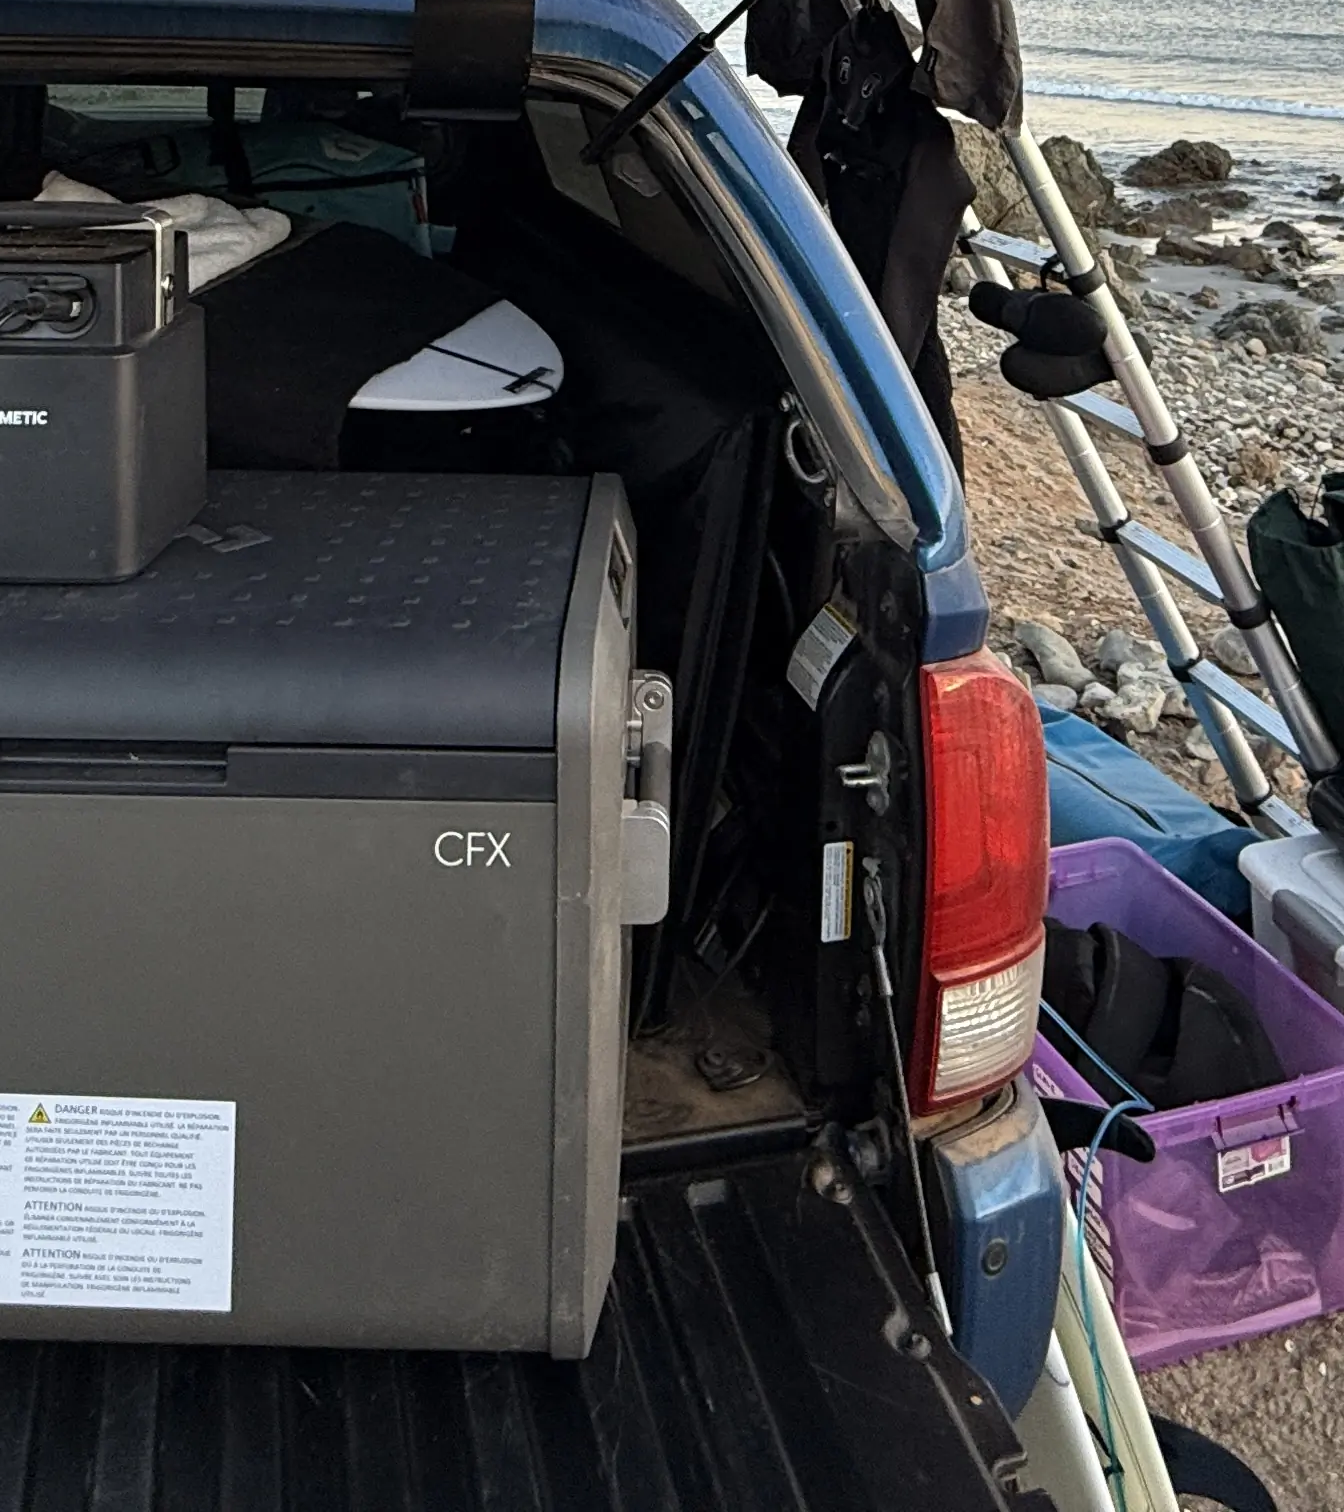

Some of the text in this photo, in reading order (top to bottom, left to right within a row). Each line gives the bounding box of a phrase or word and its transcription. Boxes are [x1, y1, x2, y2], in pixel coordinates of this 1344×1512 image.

[434, 831, 511, 868] CFX
[56, 1104, 97, 1115] DANGER
[24, 1201, 82, 1211] ATTENTION
[23, 1249, 80, 1259] ATTENTION
